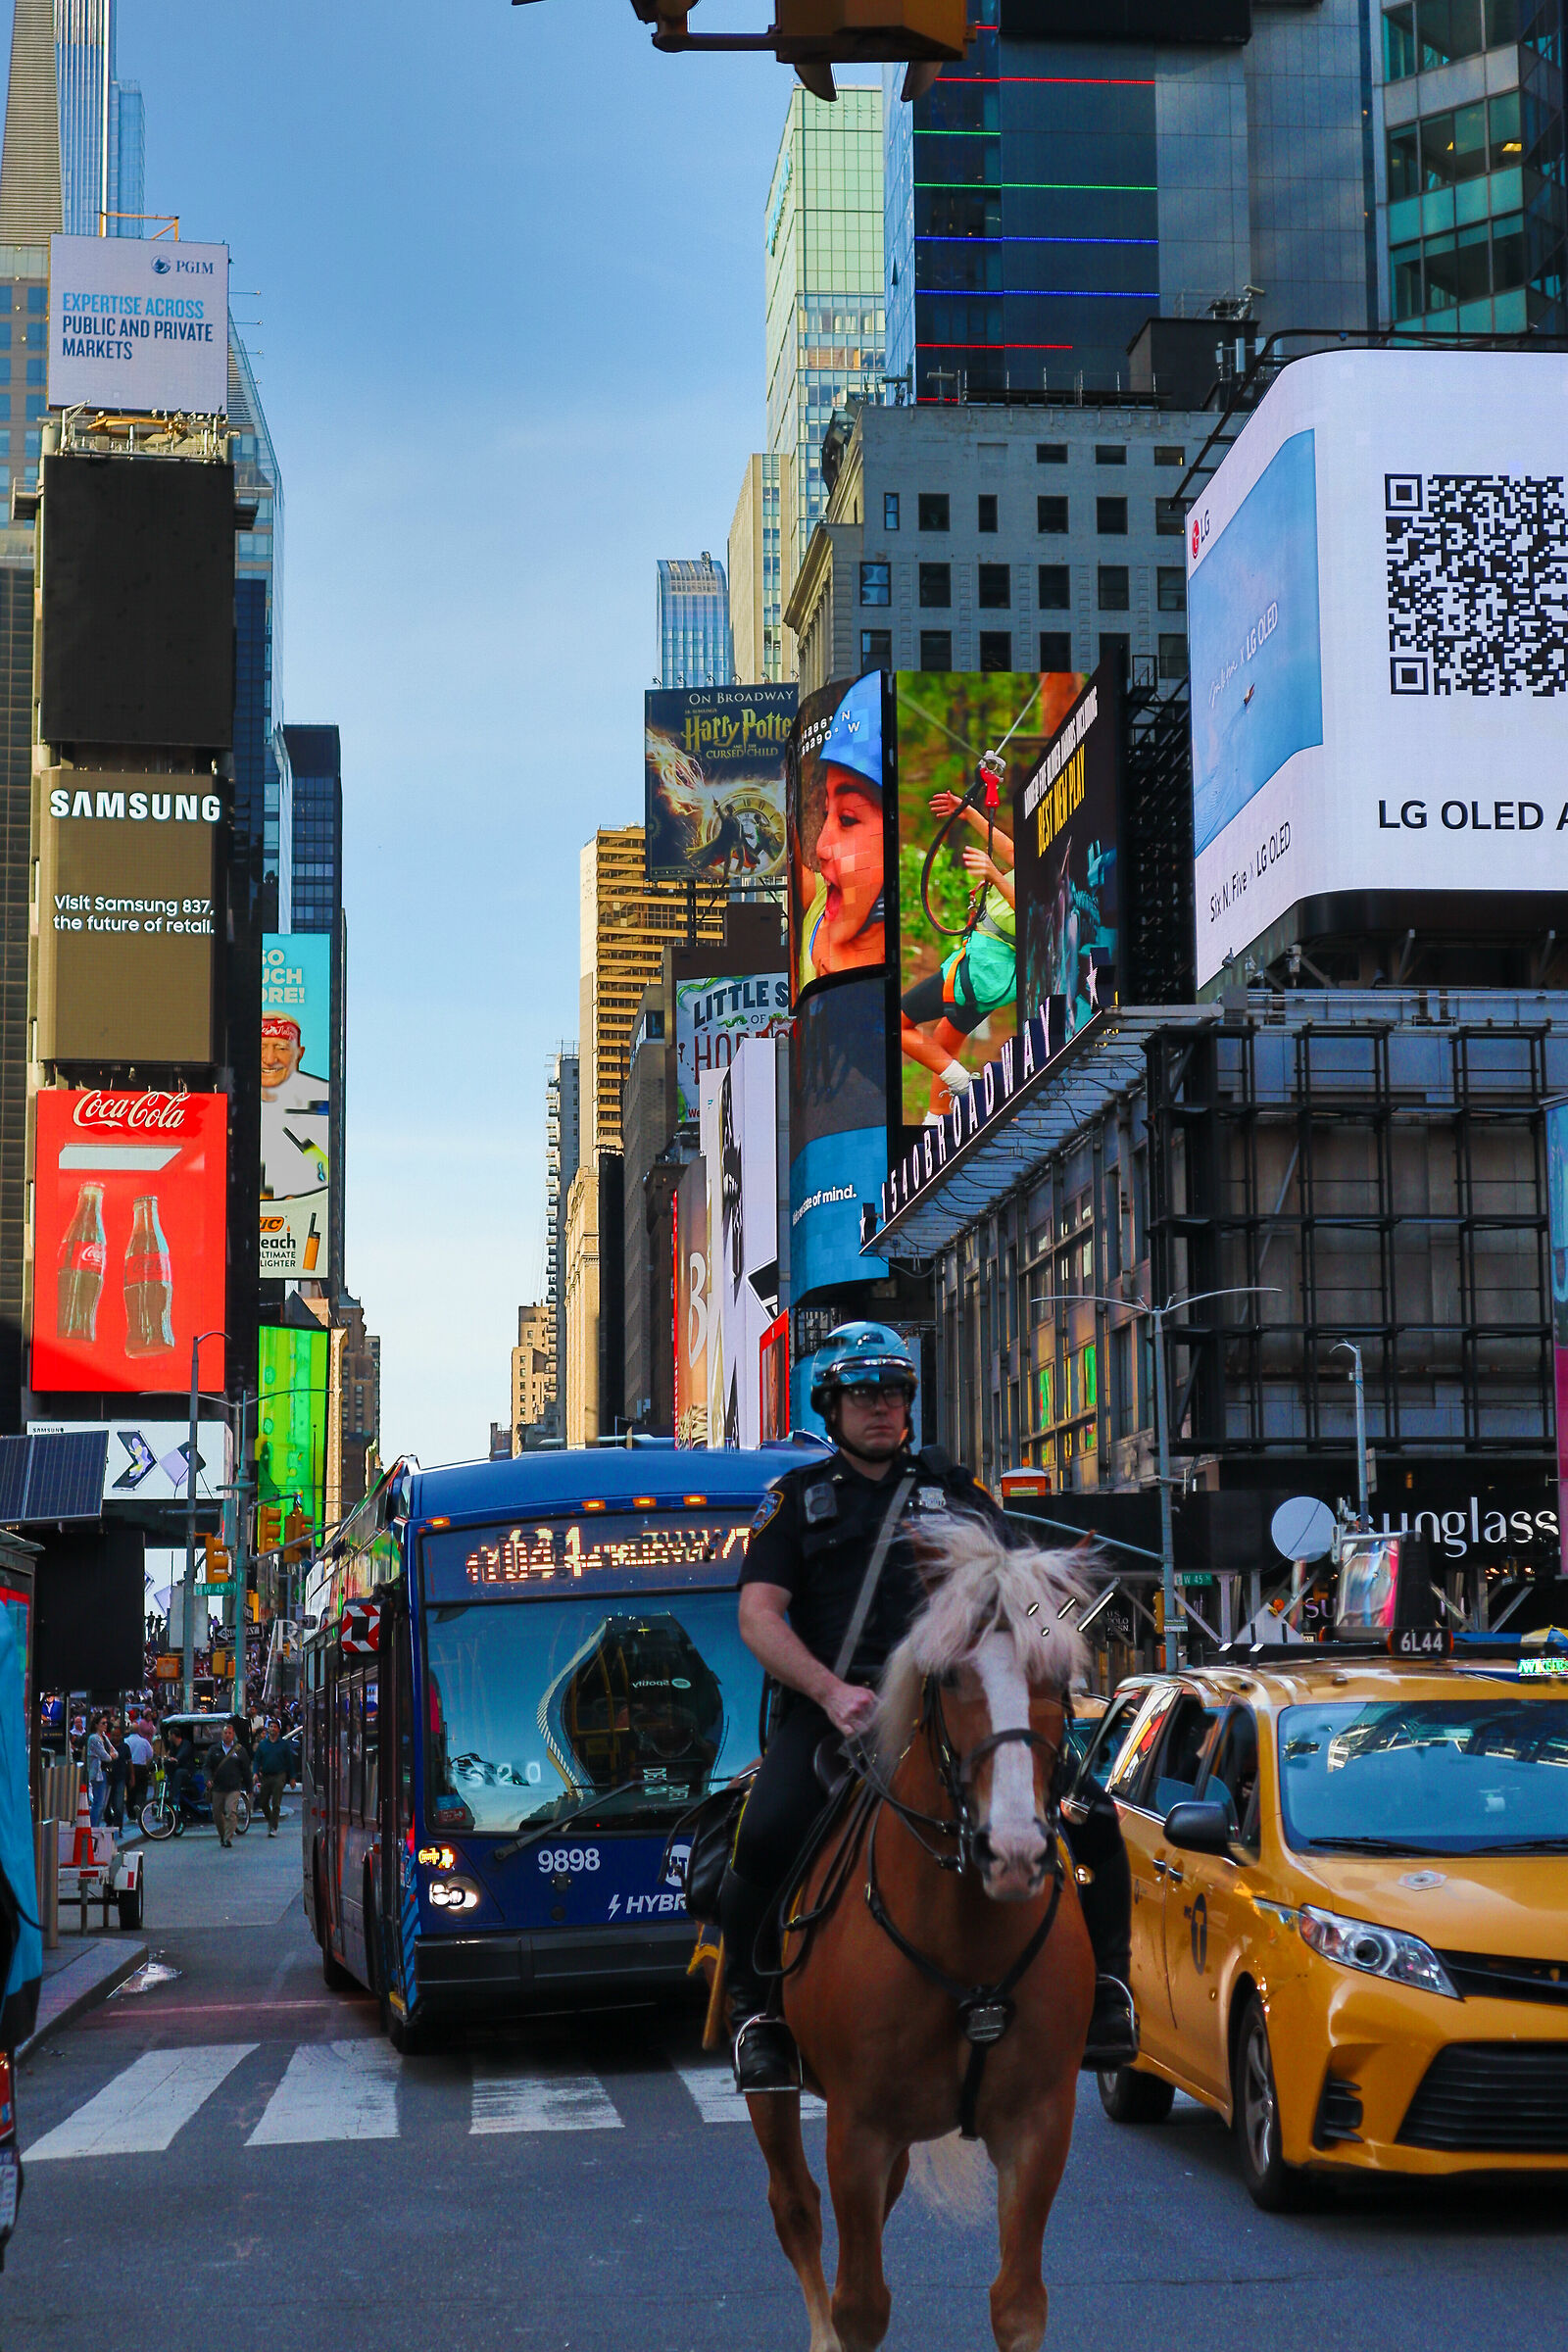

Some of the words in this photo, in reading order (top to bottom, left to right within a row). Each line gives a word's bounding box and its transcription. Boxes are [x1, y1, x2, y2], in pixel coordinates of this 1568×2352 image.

[176, 260, 214, 274] PGIM
[63, 292, 142, 315] EXPERTISE
[145, 297, 204, 319] ACROSS
[63, 315, 116, 335] PUBLIC
[120, 318, 150, 338] AND
[154, 320, 214, 342] PRIVATE
[63, 337, 133, 360] MARKETS
[1200, 510, 1210, 542] LG
[1247, 627, 1257, 661] LG
[1257, 602, 1278, 646] OLED
[689, 692, 711, 705] ON
[716, 690, 794, 704] BROADWAY
[680, 715, 740, 753] Harry
[848, 721, 860, 733] W
[706, 749, 745, 759] CURSED
[747, 747, 779, 758] CHILD
[49, 788, 221, 822] SAMSUNG
[1038, 789, 1054, 858] BEST
[1054, 767, 1068, 836] NEW
[1068, 743, 1085, 815] PLAY
[1379, 800, 1428, 829] LG
[1441, 800, 1544, 831] OLED
[1210, 892, 1222, 922] Six
[1222, 882, 1231, 911] N.
[1232, 871, 1248, 902] Five
[1256, 844, 1267, 877] LG
[1269, 821, 1291, 863] OLED
[54, 894, 90, 910] Visit
[94, 896, 178, 916] Samsung
[181, 899, 215, 915] 837,
[53, 914, 82, 930] the
[86, 914, 140, 931] future
[144, 917, 163, 932] of
[166, 919, 216, 934] retail.
[694, 981, 769, 1029] LITTLE
[751, 1014, 766, 1025] OF
[73, 1090, 191, 1129] Coca-Cola
[881, 1145, 921, 1223] 1540
[923, 996, 1051, 1179] BROADWAY
[811, 1190, 822, 1206] of
[822, 1184, 858, 1203] mind.
[260, 1218, 282, 1230] IC
[260, 1250, 296, 1259] LTIMATE
[1355, 1496, 1560, 1558] unglass
[204, 1586, 212, 1594] W
[1183, 1576, 1191, 1585] W
[1194, 1576, 1203, 1585] 45
[1400, 1632, 1444, 1652] 6L44
[538, 1847, 601, 1874] 9898
